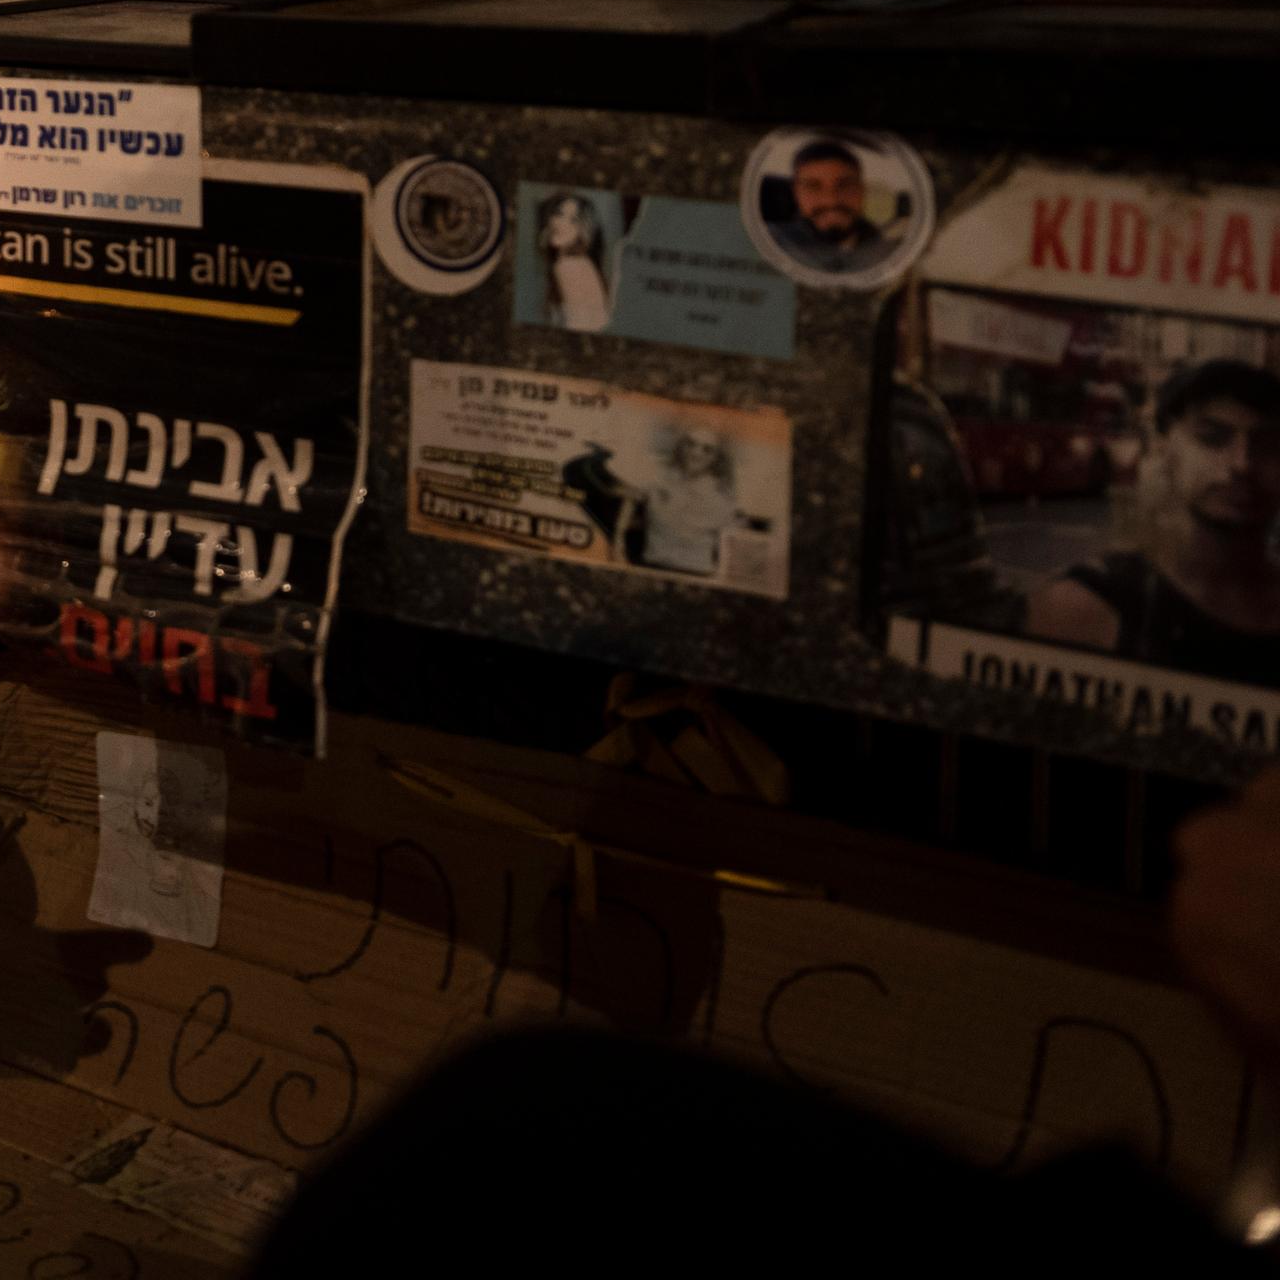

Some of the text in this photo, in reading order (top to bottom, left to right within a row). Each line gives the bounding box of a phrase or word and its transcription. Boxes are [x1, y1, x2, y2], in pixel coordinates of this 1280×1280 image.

[38, 124, 89, 151] הוא
[98, 129, 185, 157] עכשיו
[12, 186, 57, 205] שרמן
[63, 190, 87, 209] רון
[92, 192, 118, 210] את
[124, 194, 182, 214] זוכרים
[1032, 197, 1280, 296] KIDNA
[63, 230, 94, 270] is
[105, 231, 177, 282] still
[190, 244, 304, 297] alive.
[494, 379, 559, 401] עמית
[39, 399, 313, 512] אבינתן
[93, 505, 293, 604] עדיין
[58, 602, 277, 718] בחיים
[962, 651, 1280, 748] JONATHAN SA
